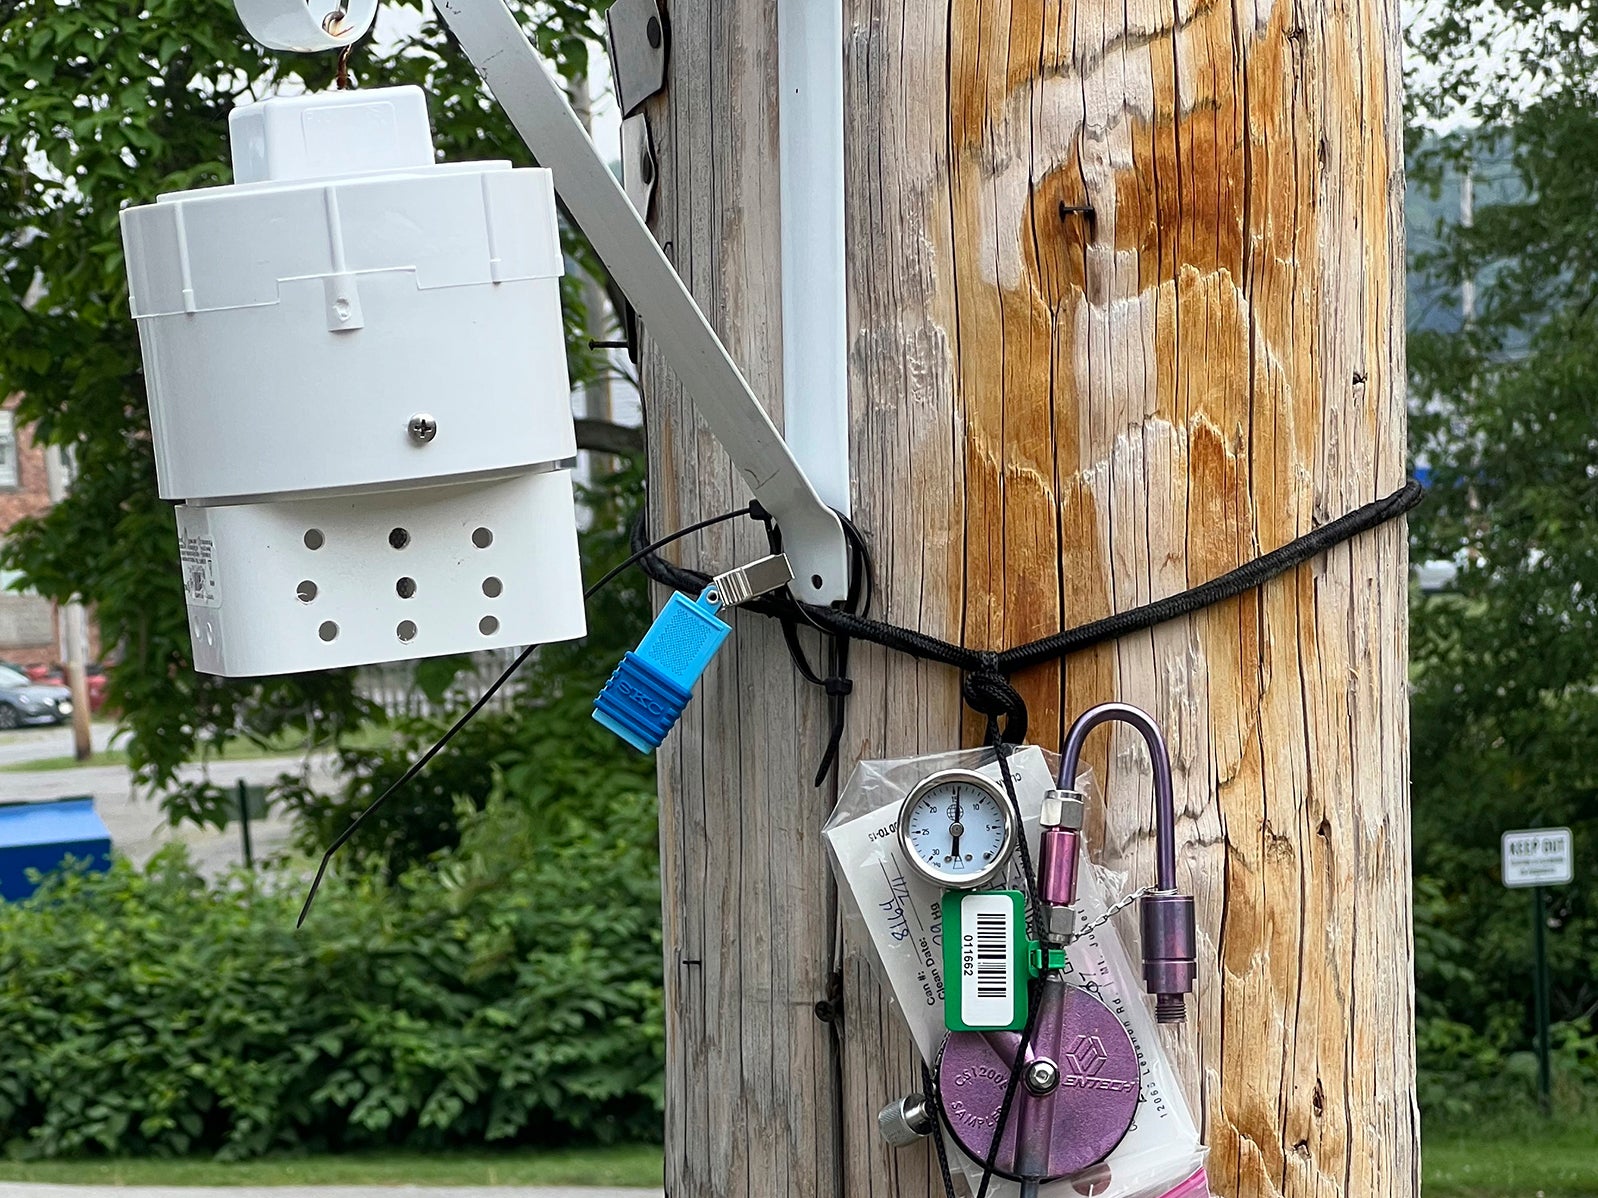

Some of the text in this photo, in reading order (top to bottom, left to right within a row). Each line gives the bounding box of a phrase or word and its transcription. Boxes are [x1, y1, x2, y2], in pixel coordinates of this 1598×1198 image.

[617, 680, 664, 715] SKC
[929, 806, 938, 814] 20
[972, 803, 980, 811] 10
[868, 824, 891, 842] TO-15
[921, 828, 930, 836] 25
[985, 824, 991, 832] 5
[932, 848, 940, 856] 30
[878, 898, 910, 941] 8164
[918, 938, 936, 968] Date:
[963, 934, 973, 976] 011662
[923, 983, 936, 1006] Can
[1062, 1074, 1138, 1093] ENTECH
